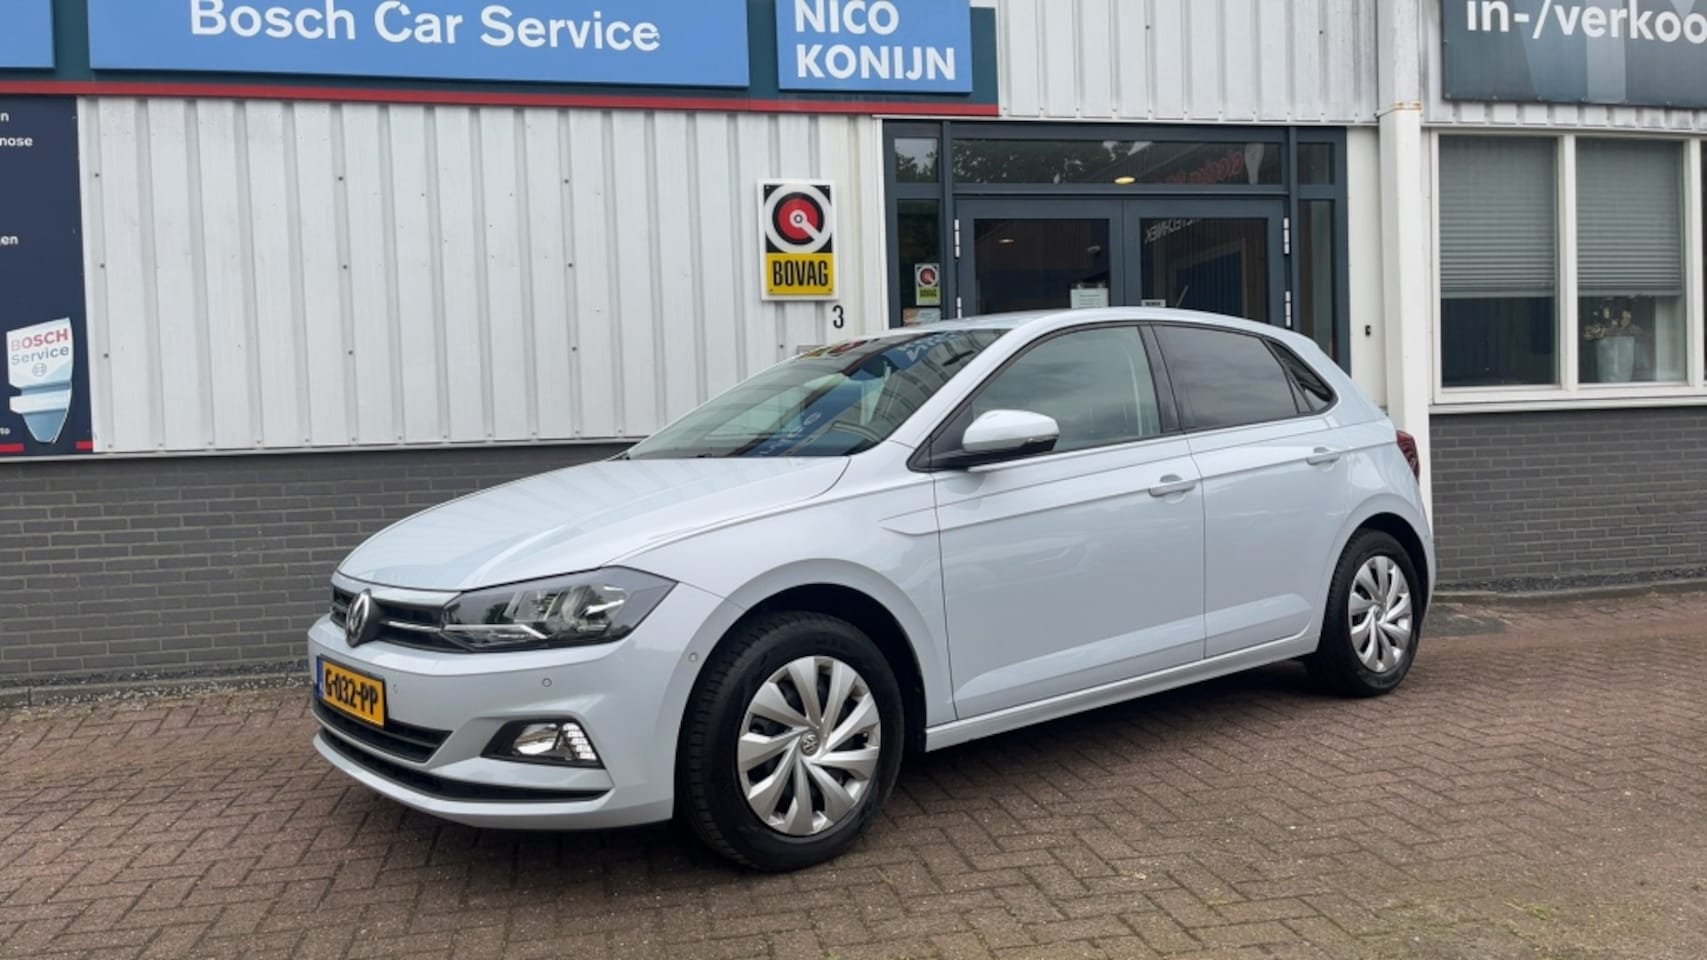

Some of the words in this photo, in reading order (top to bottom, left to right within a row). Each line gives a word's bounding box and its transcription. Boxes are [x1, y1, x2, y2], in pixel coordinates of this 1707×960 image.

[190, 0, 356, 40] Bosch
[374, 0, 463, 44] Car
[480, 5, 661, 50] Service
[794, 0, 900, 35] NICO
[796, 44, 956, 81] KONIJN
[772, 260, 829, 287] BOVAG
[832, 304, 844, 329] 3
[10, 327, 69, 352] BOSCH
[11, 345, 70, 366] Service
[325, 668, 378, 716] G-032-PP
